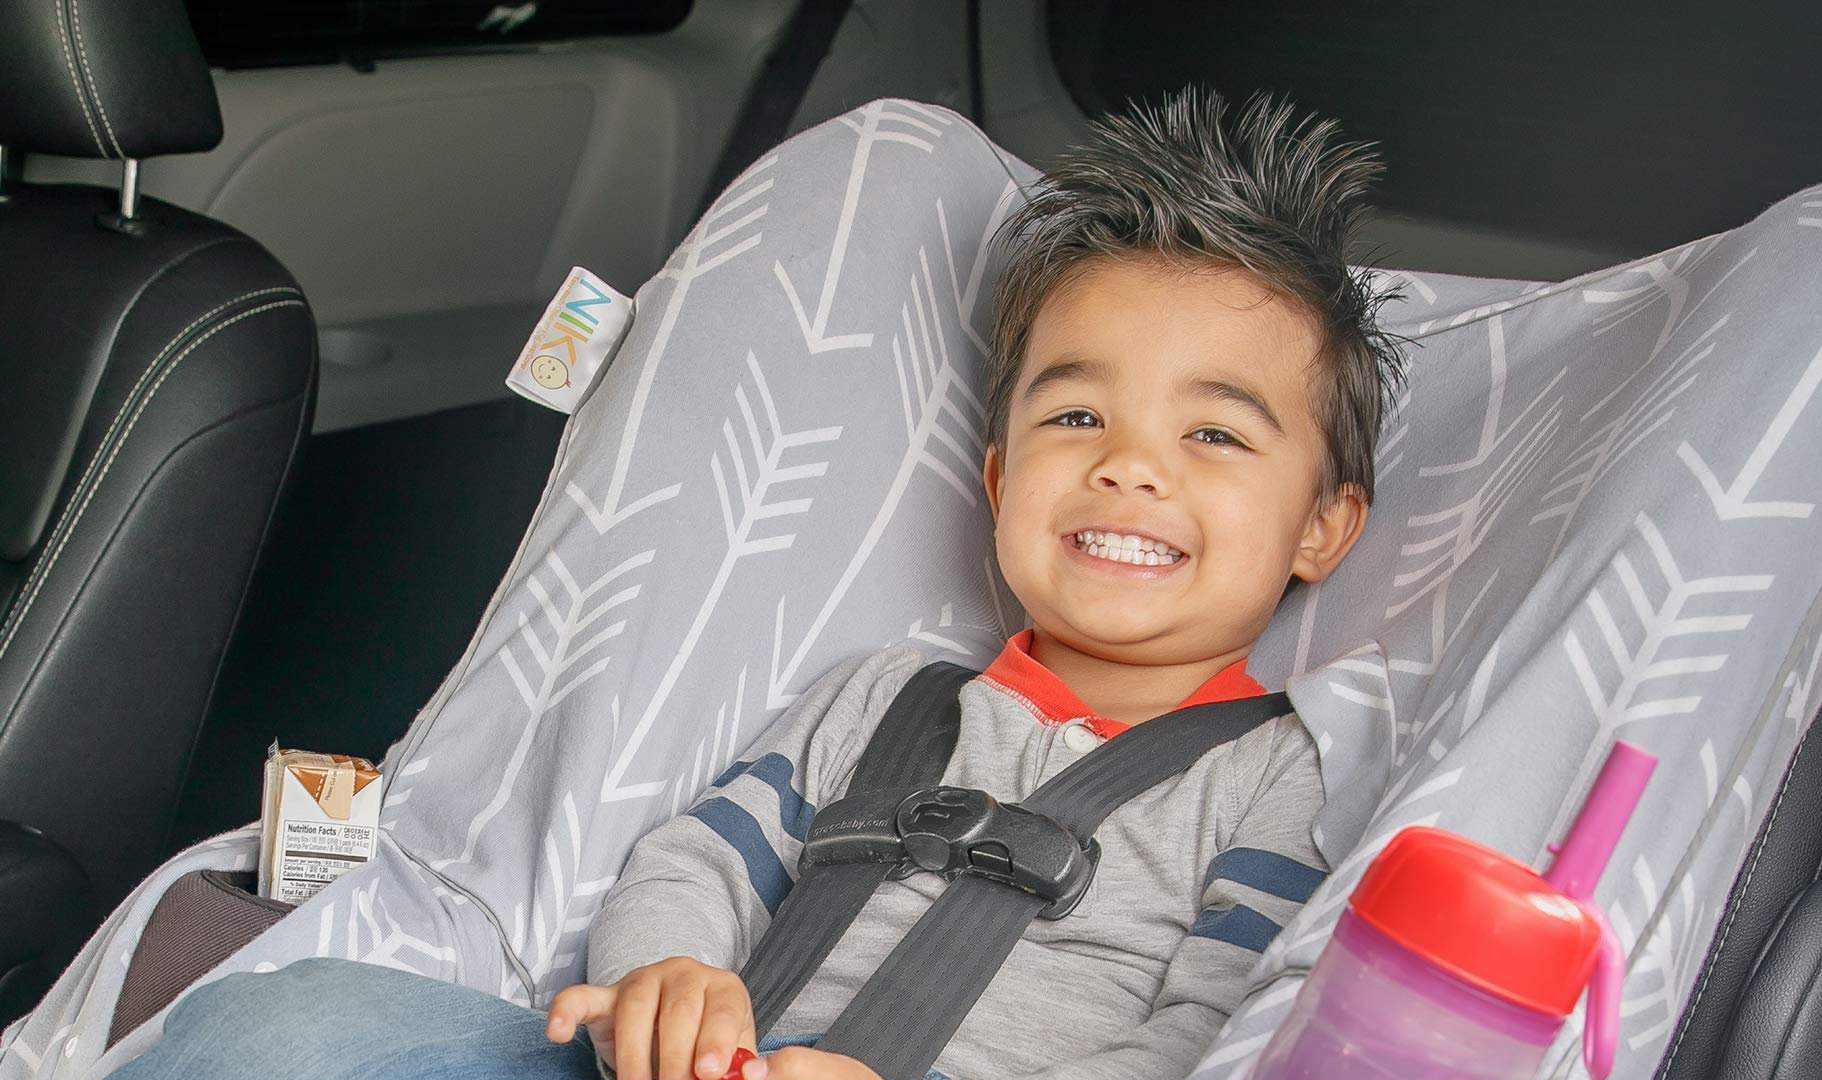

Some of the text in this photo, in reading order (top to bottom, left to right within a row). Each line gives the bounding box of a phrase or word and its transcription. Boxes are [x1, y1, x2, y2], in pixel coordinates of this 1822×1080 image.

[288, 824, 317, 834] Nutrition
[318, 826, 337, 836] Facts
[343, 827, 370, 840] 영양정보
[812, 819, 889, 837] gracobaby.com
